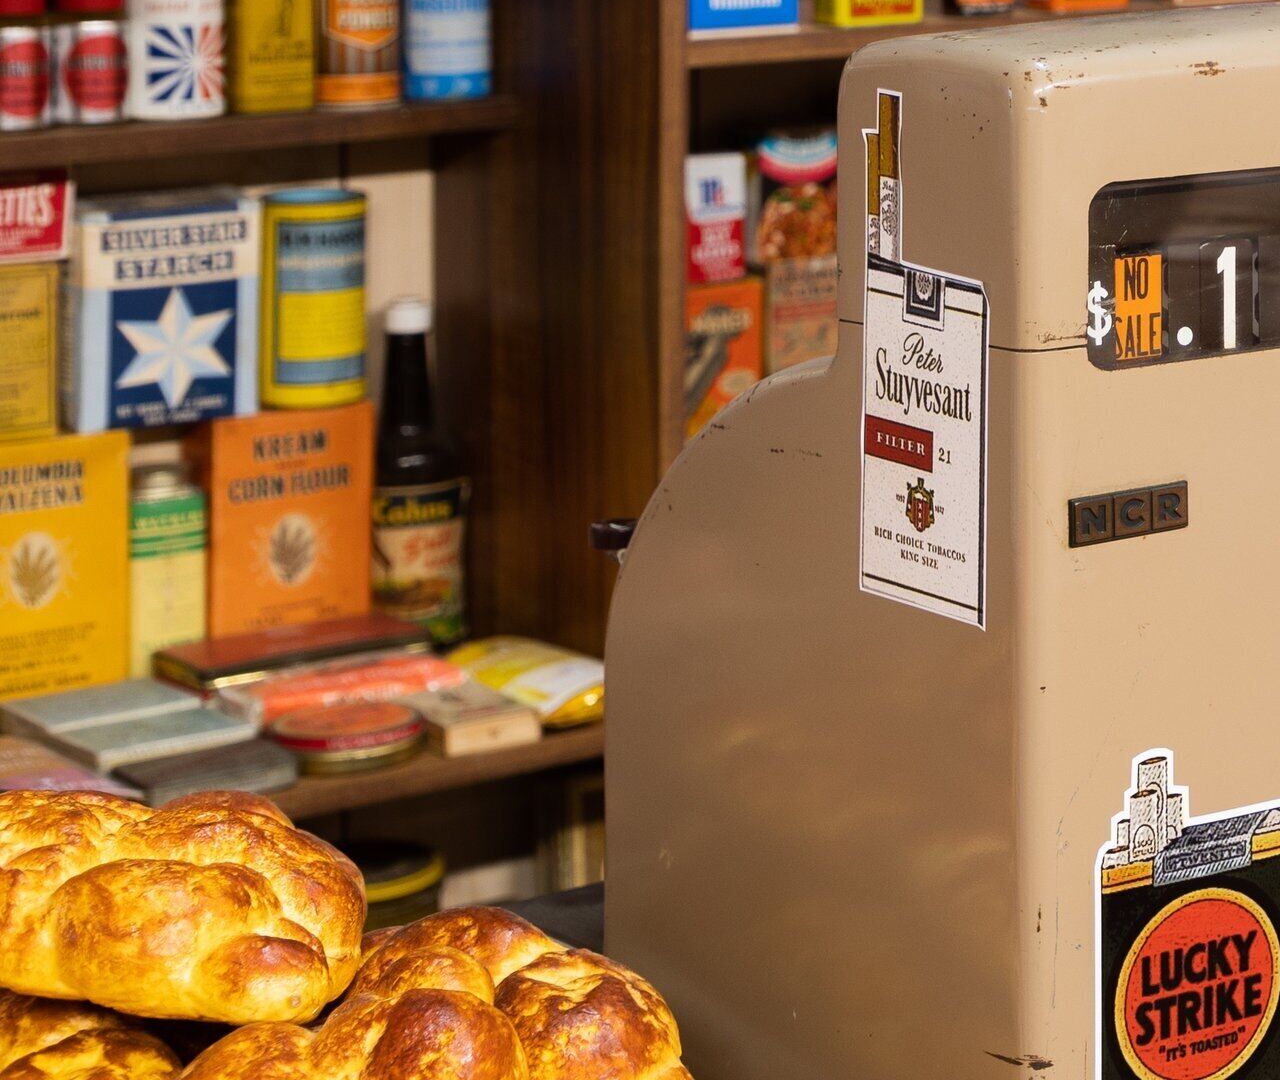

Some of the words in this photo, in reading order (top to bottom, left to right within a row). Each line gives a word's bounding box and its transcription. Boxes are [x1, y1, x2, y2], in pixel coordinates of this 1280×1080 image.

[1123, 257, 1150, 302] NO
[901, 331, 945, 374] Peter
[1114, 312, 1162, 360] SALE
[875, 347, 973, 423] Stuyvesant
[876, 431, 927, 457] FILTER
[938, 446, 953, 466] 21
[1079, 492, 1185, 537] NCR
[873, 525, 894, 542] RICH
[895, 532, 925, 551] CHOICE
[926, 541, 967, 564] TOBACCOS
[900, 548, 920, 564] KING
[921, 554, 940, 571] SIZE
[1140, 929, 1259, 998] LUCKY
[1134, 972, 1264, 1048] STRIKE
